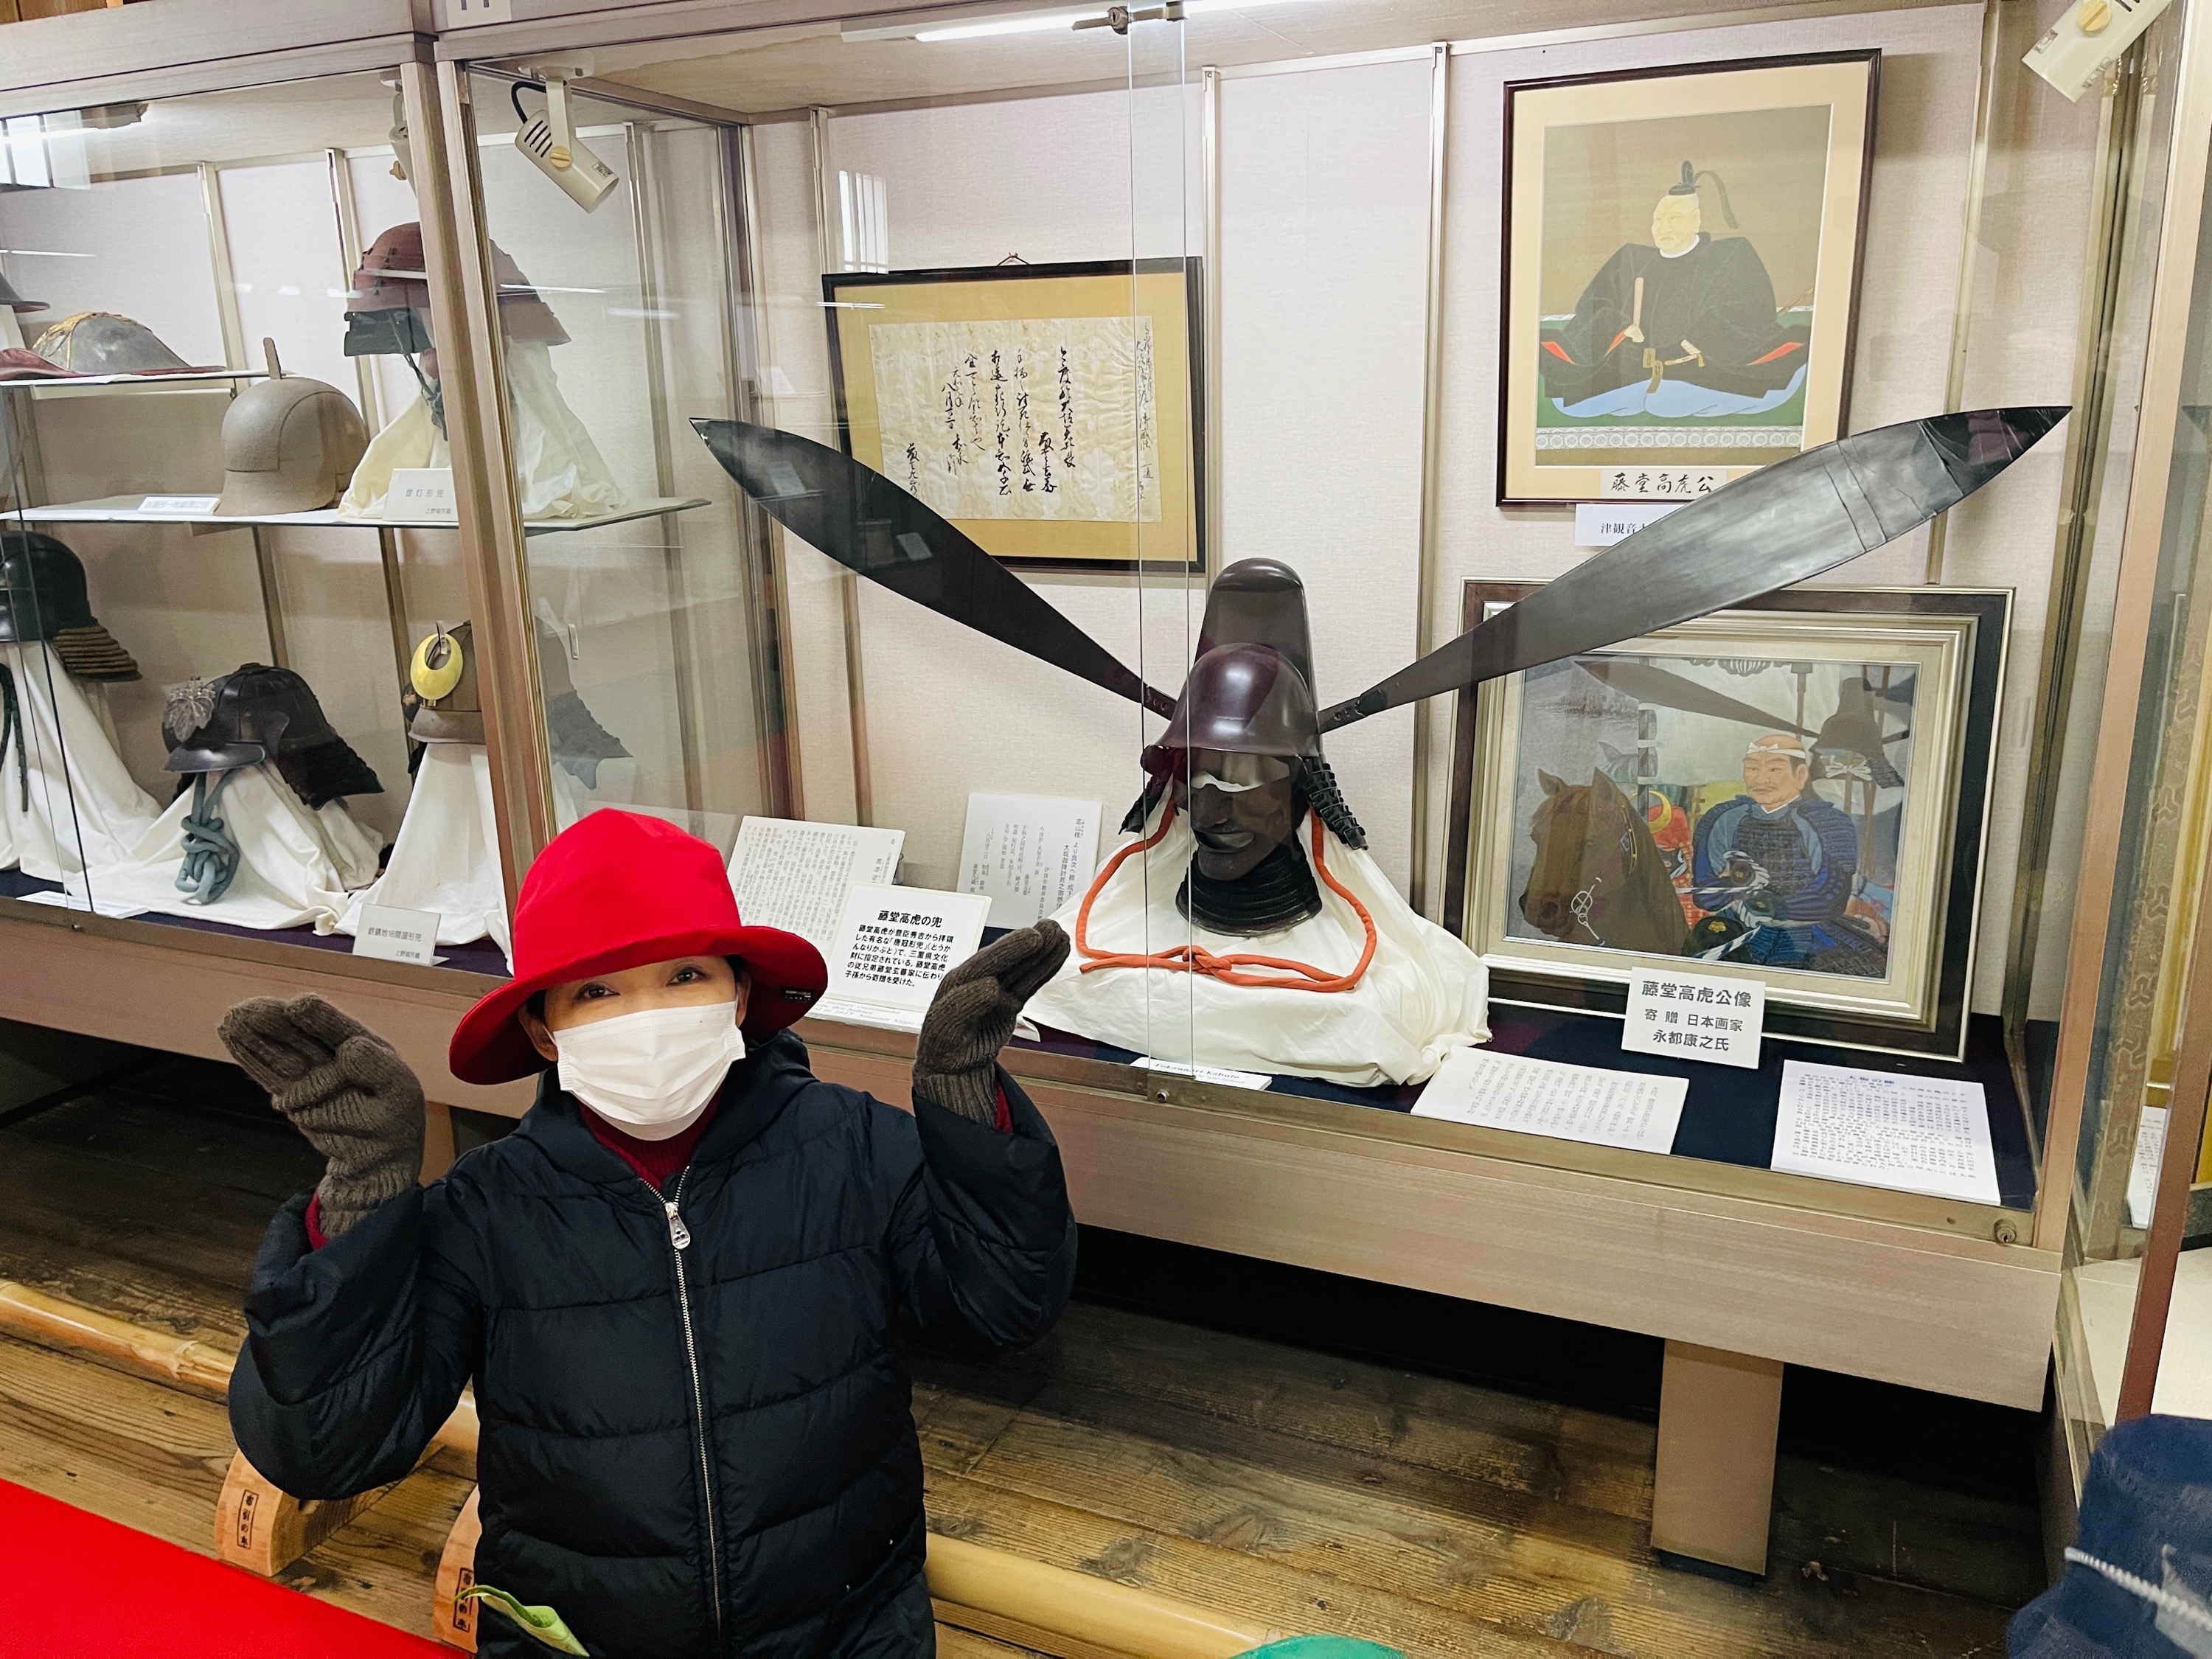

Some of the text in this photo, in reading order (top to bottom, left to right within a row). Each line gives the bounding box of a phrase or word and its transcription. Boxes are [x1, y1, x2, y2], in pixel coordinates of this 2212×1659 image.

[1610, 473, 1715, 494] 藤堂高虎公
[877, 910, 942, 928] 藤堂高虎の兜
[858, 924, 953, 943] 藤堂高虎が豊臣秀吉から拝領
[849, 952, 946, 971] 財に指定されている。藤堂高虎
[845, 970, 915, 987] 子孫から寄贈を受けた。
[1642, 980, 1752, 1008] 藤堂高虎公像
[1687, 1014, 1743, 1032] 日本画家
[1652, 1029, 1729, 1051] 永都康之氏
